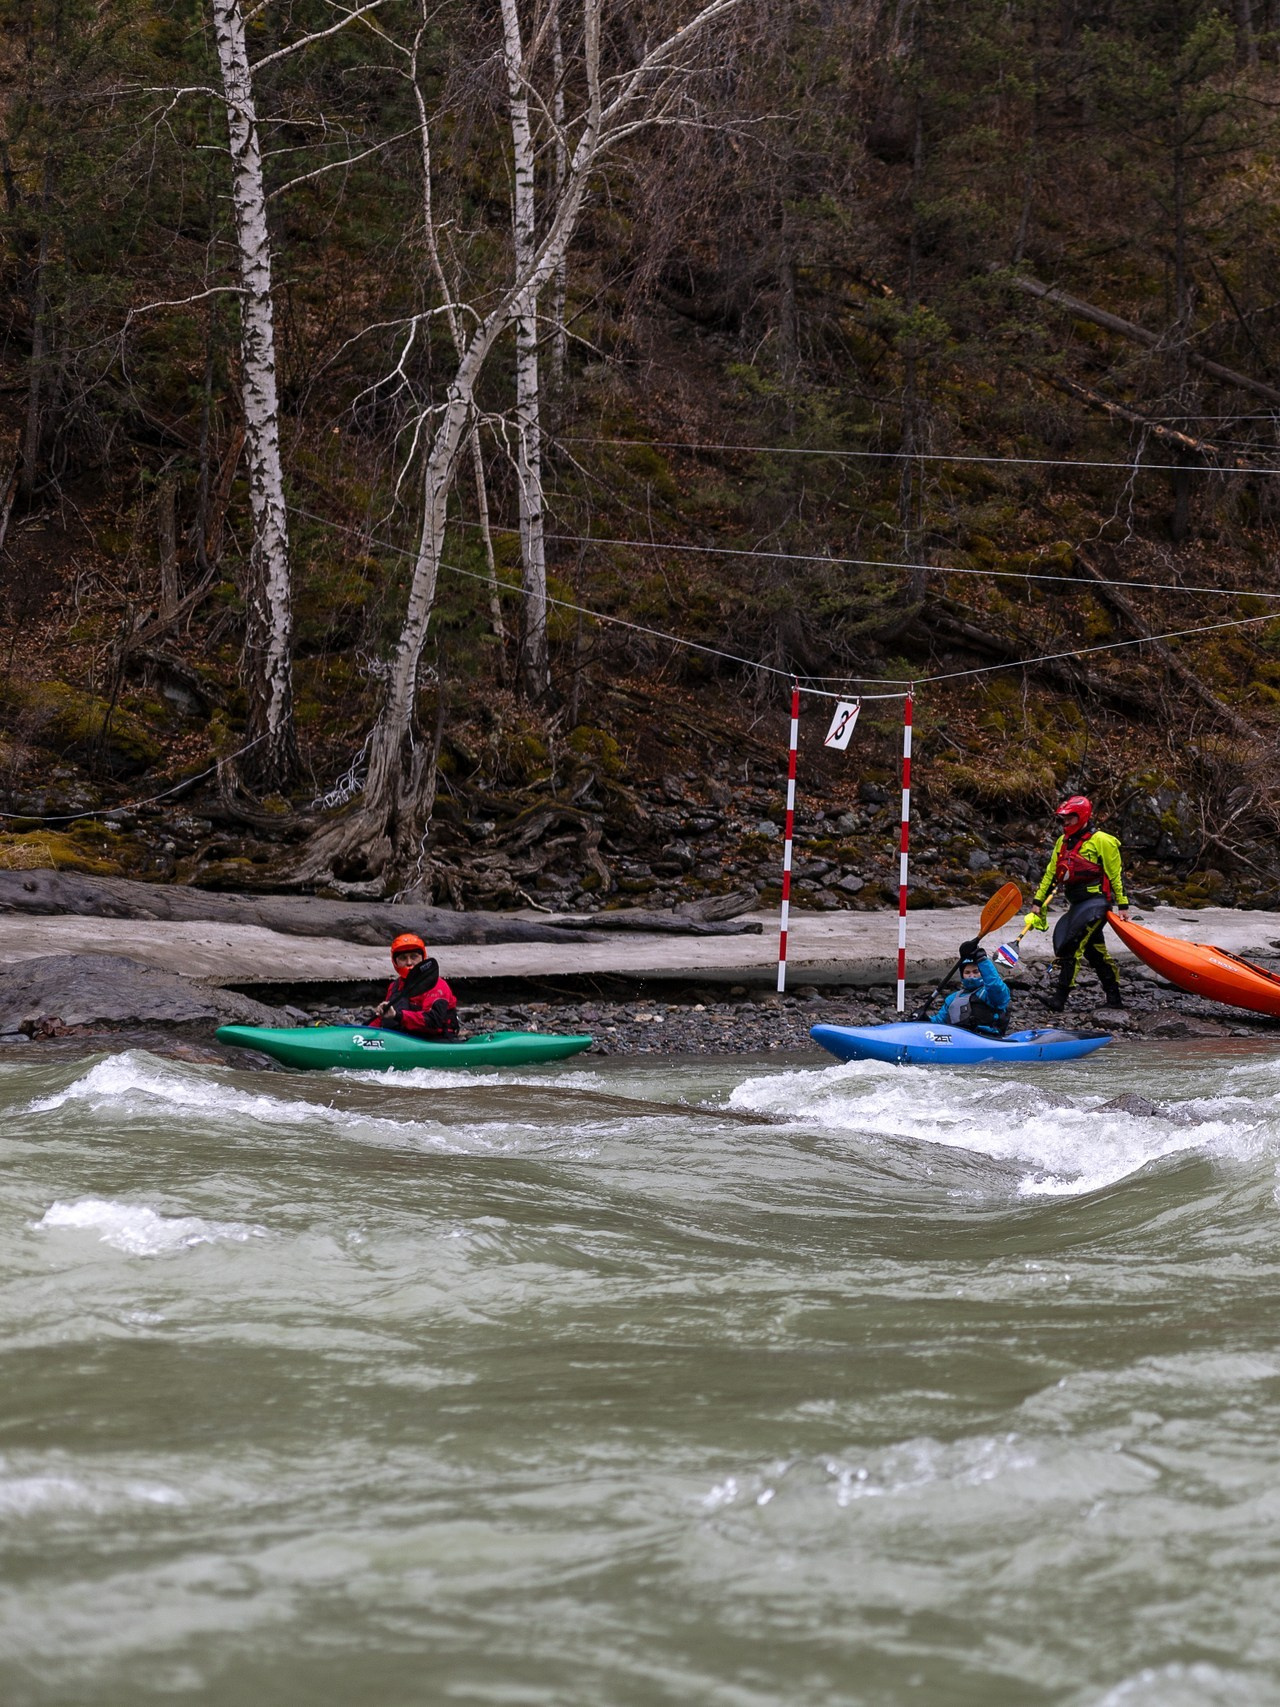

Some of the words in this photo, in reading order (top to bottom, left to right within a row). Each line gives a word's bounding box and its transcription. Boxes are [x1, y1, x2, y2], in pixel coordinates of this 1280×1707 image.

[834, 710, 849, 741] 3
[934, 1034, 952, 1043] ZET
[363, 1039, 385, 1048] ZET
